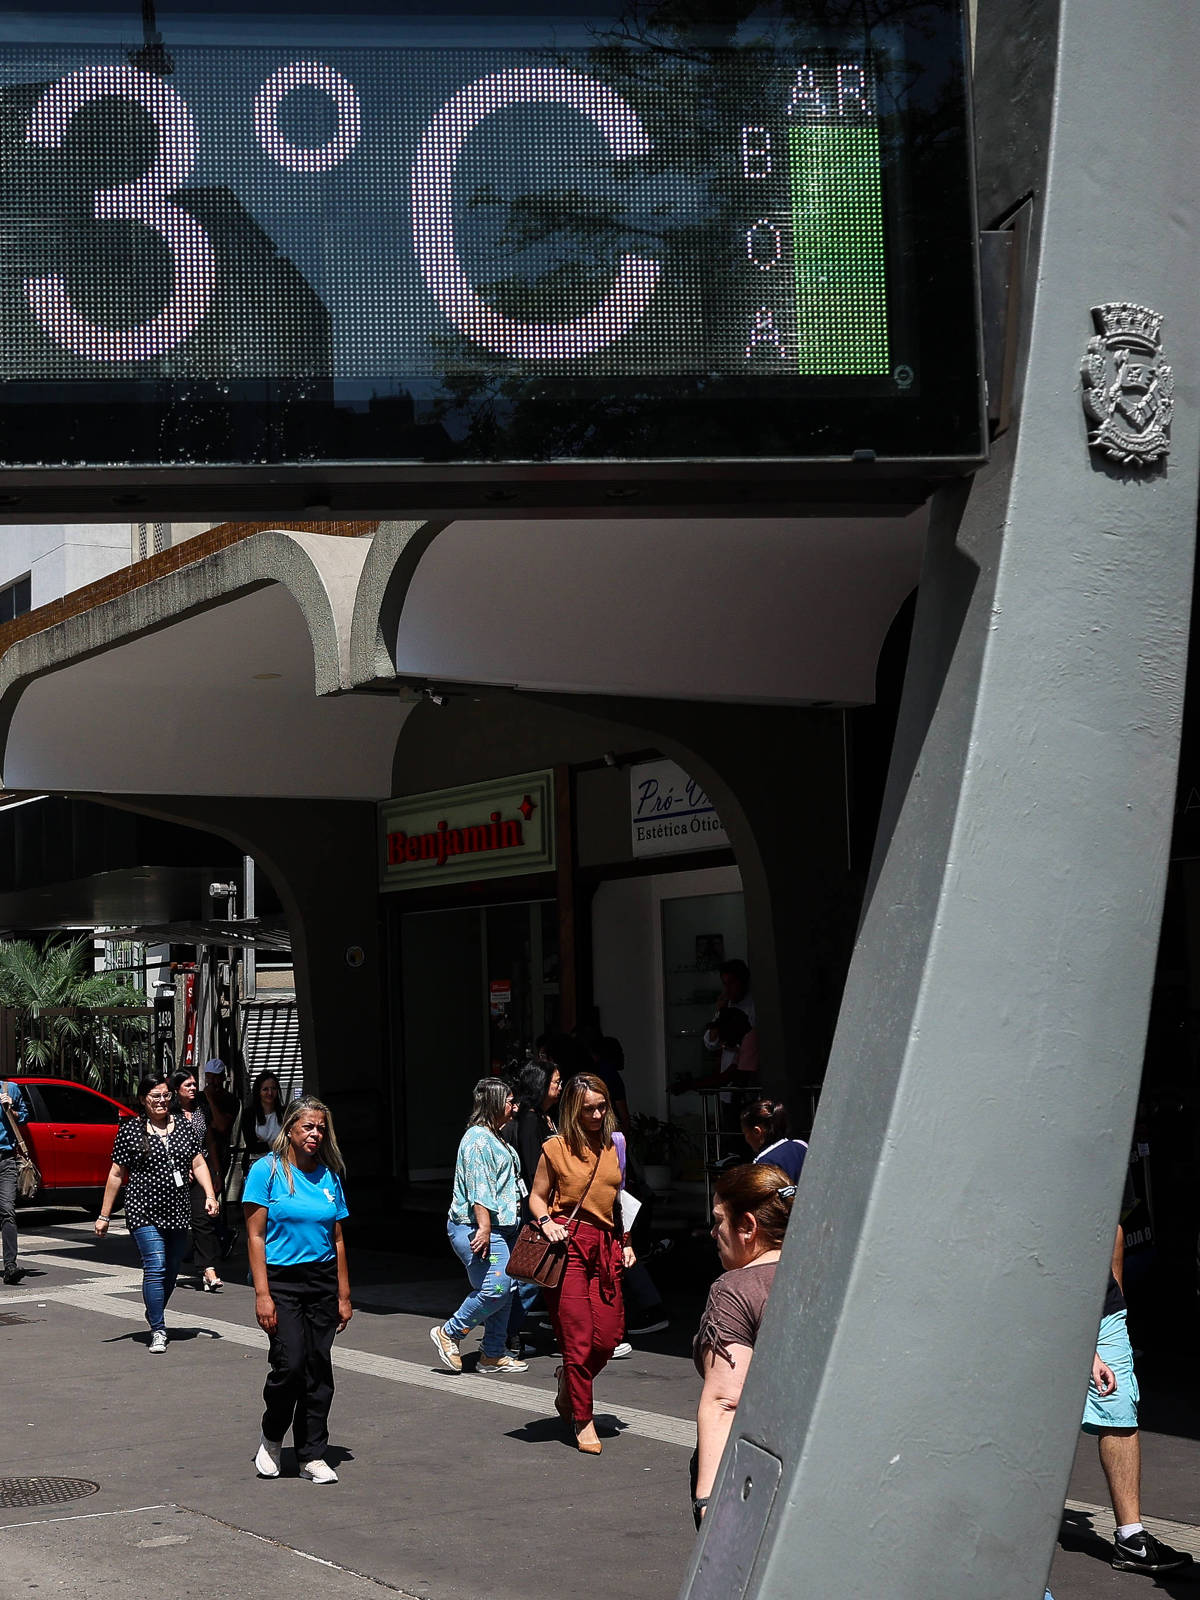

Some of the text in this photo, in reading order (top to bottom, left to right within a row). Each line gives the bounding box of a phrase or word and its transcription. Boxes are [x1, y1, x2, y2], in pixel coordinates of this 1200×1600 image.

[787, 63, 873, 118] AR
[637, 778, 712, 815] Pró-V
[386, 811, 525, 866] Benjamin
[637, 822, 688, 841] Estética
[158, 1010, 172, 1028] 1439
